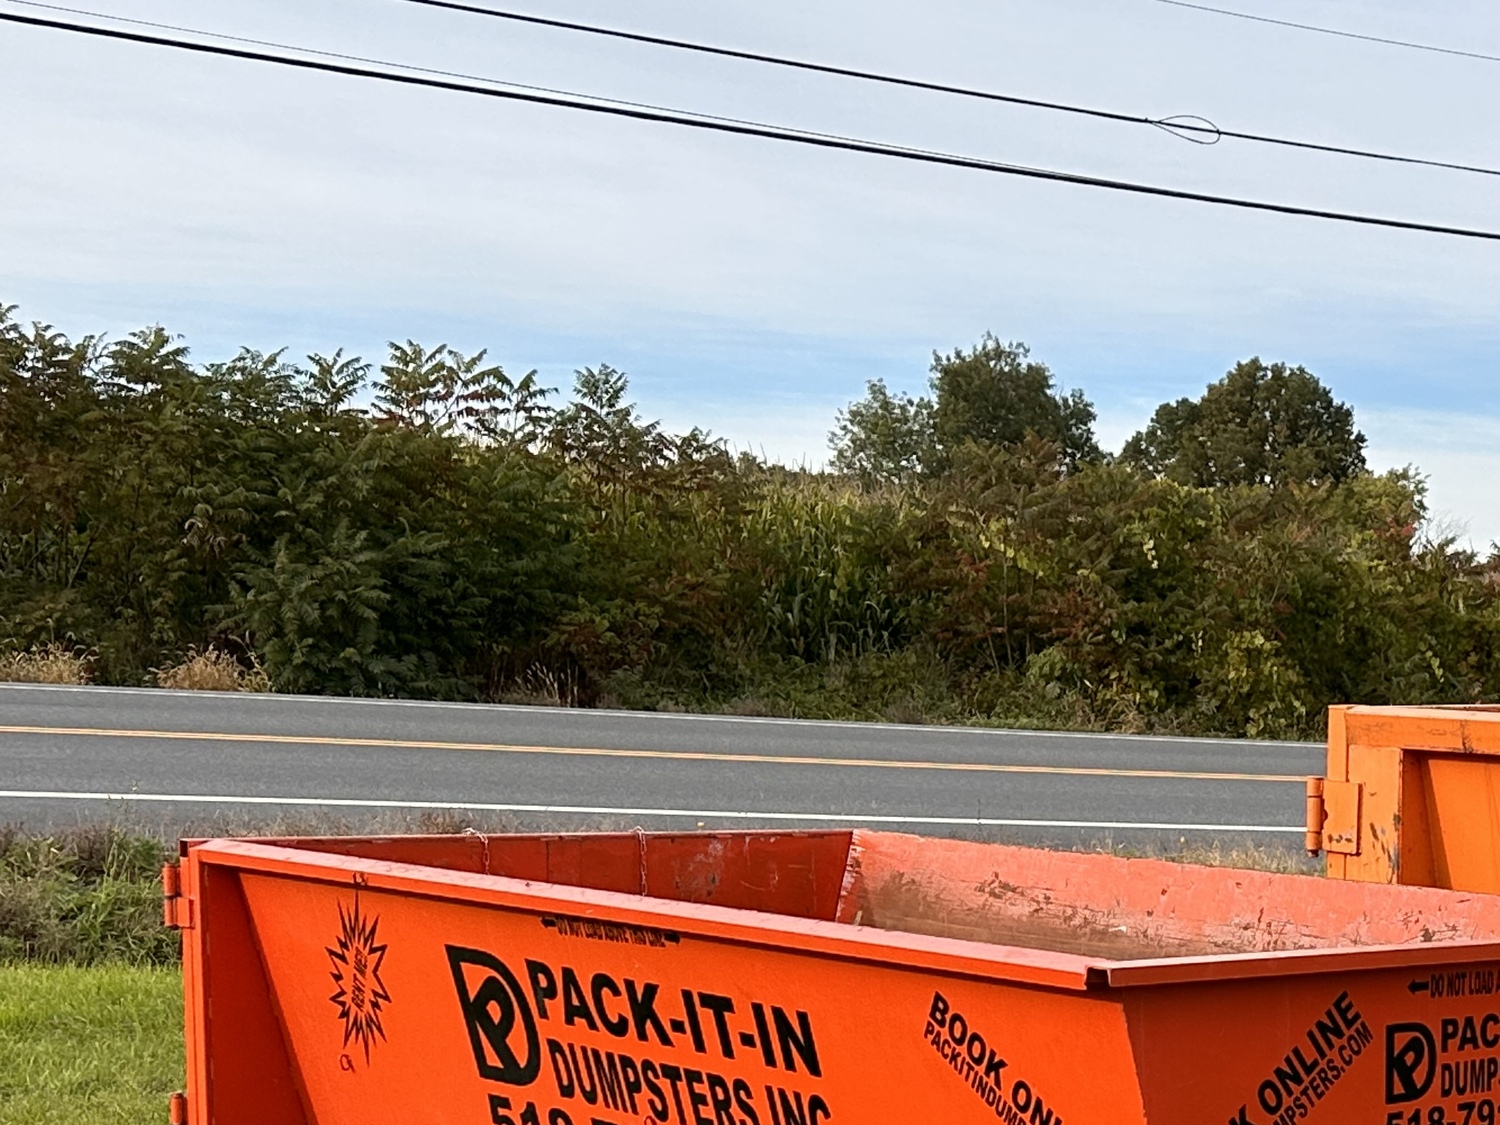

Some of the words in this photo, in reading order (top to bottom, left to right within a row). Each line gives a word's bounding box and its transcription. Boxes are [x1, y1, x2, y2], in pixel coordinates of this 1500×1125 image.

[524, 958, 822, 1078] PACK-IT-IN
[1430, 973, 1444, 998] DO
[1447, 971, 1467, 997] NOT
[1468, 969, 1494, 995] LOAD
[929, 991, 1008, 1091] BOOK
[1257, 990, 1362, 1116] ONLINE
